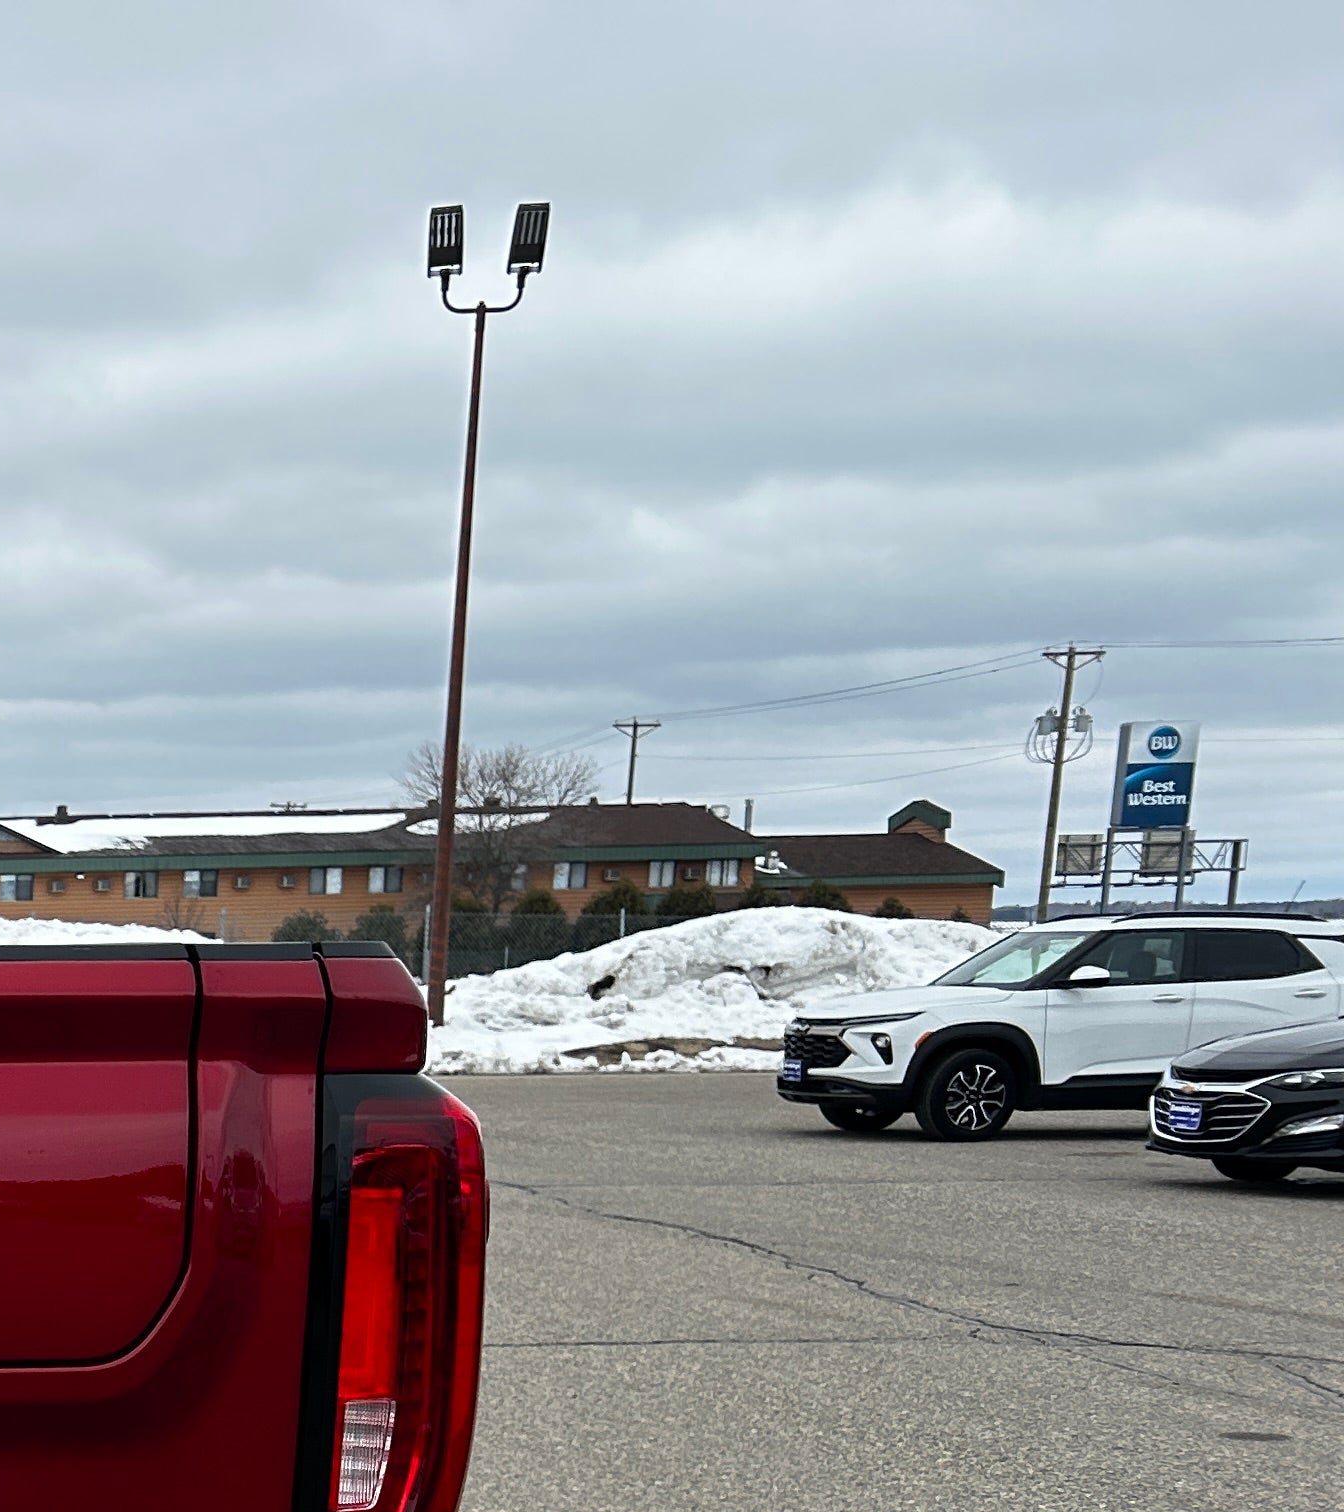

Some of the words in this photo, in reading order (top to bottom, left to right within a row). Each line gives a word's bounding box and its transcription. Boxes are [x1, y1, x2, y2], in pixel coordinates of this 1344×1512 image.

[1151, 736, 1178, 750] BW
[1143, 780, 1176, 792] Best
[1128, 794, 1186, 806] Western
